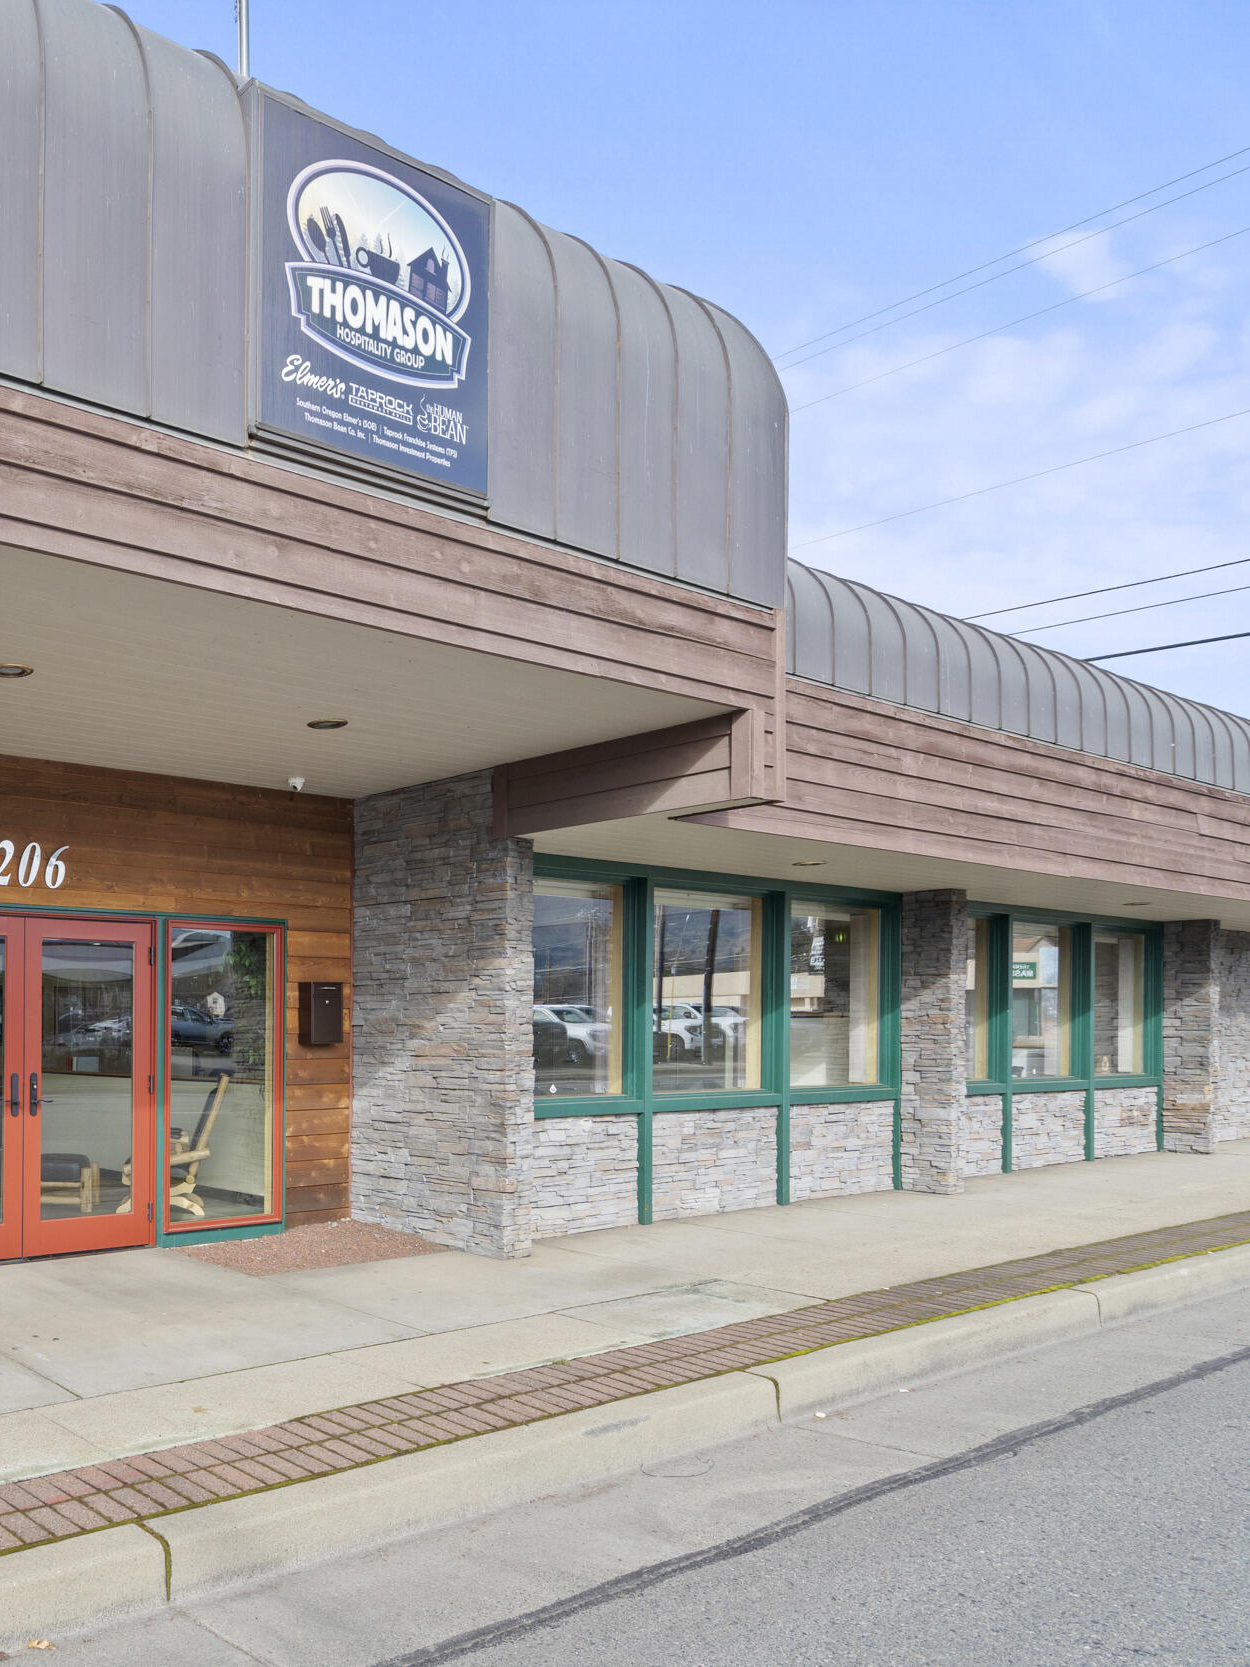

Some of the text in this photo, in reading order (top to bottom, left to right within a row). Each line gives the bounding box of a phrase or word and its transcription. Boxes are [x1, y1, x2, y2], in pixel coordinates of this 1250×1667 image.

[306, 275, 454, 366] THOMASON
[336, 323, 425, 370] HOSPITALITY GROUP
[281, 354, 346, 398] Elmer's
[296, 397, 321, 413] Southern
[321, 405, 342, 420] Oregon
[343, 412, 361, 427] Elmer's
[349, 382, 414, 416] TAPROCK
[434, 402, 463, 424] HUMAN
[304, 412, 332, 429] Thomason
[333, 421, 348, 434] Bean
[383, 426, 403, 441] Taprock
[403, 433, 426, 448] Franchise
[431, 413, 468, 446] BEAN
[372, 434, 451, 468] Thomason Investment Properties
